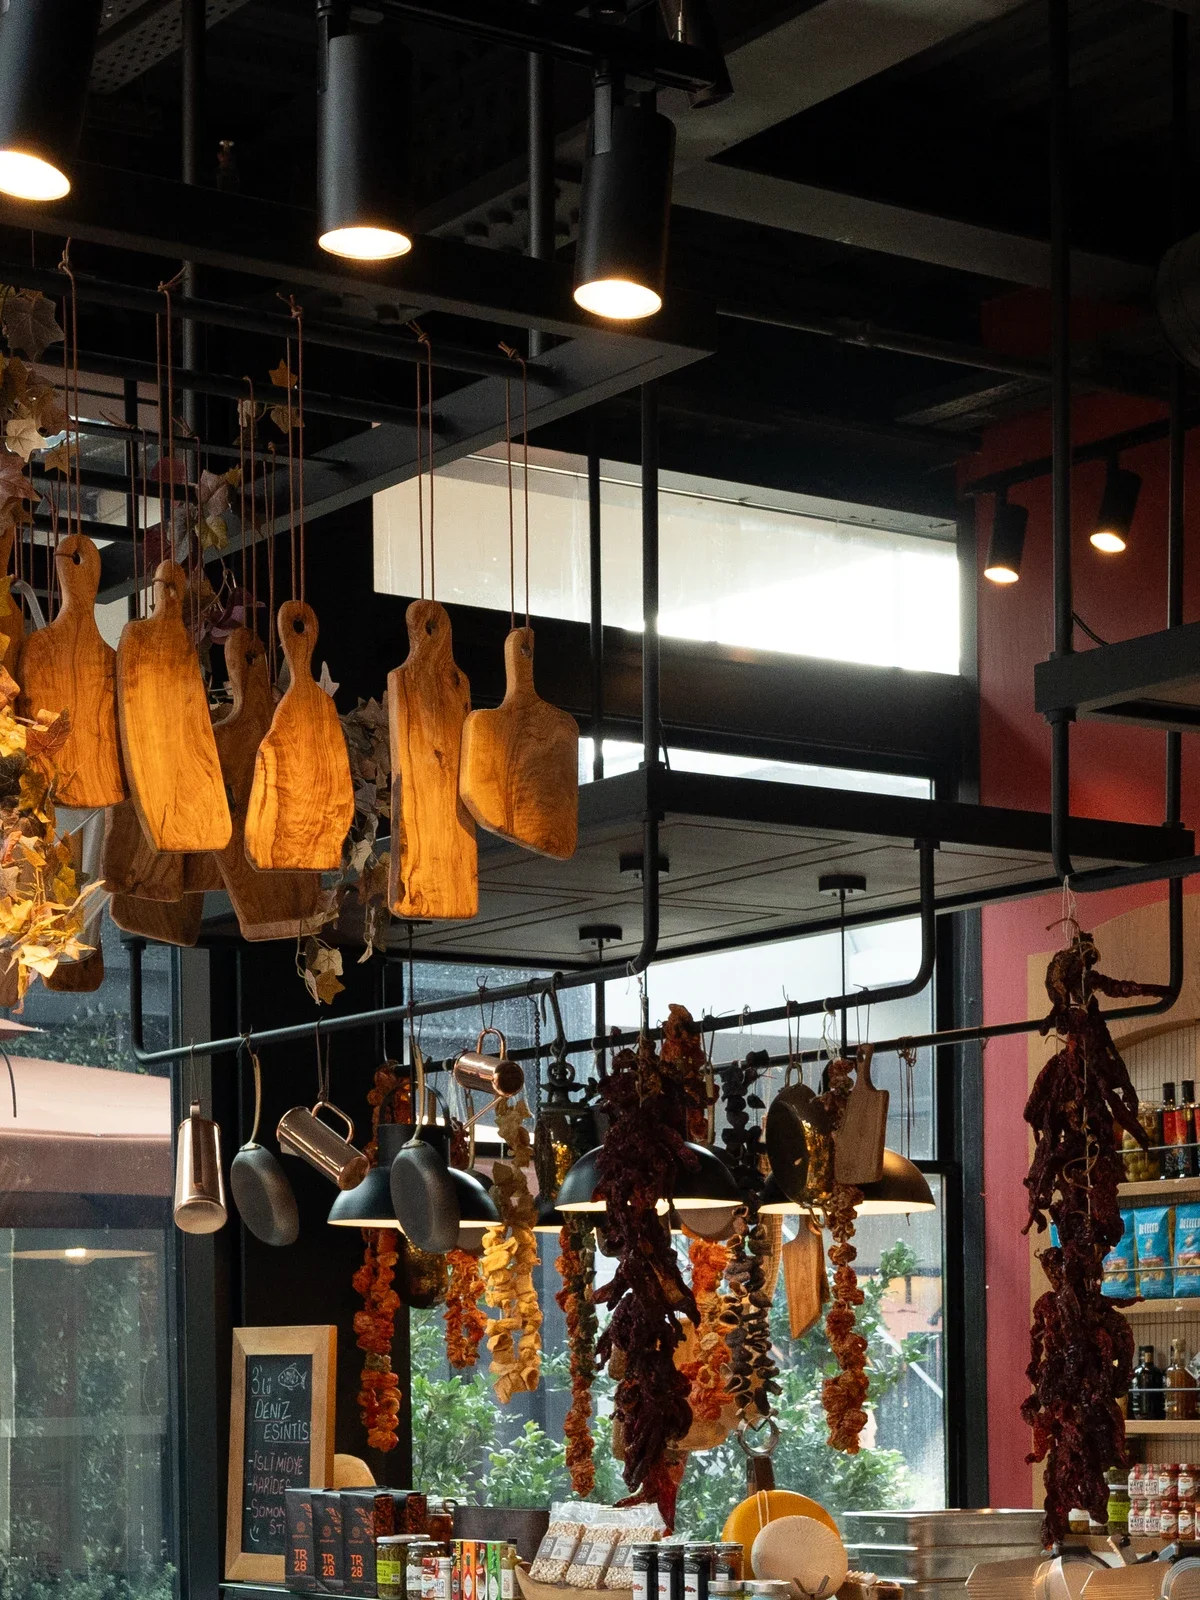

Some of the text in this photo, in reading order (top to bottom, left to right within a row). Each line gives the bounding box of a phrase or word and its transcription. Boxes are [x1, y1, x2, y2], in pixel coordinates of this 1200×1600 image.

[255, 1398, 291, 1420] DENİZ
[293, 1548, 308, 1560] TR
[321, 1553, 335, 1565] TR
[350, 1554, 364, 1566] TR
[294, 1560, 307, 1572] 28
[322, 1565, 335, 1576] 28
[351, 1566, 363, 1577] 28
